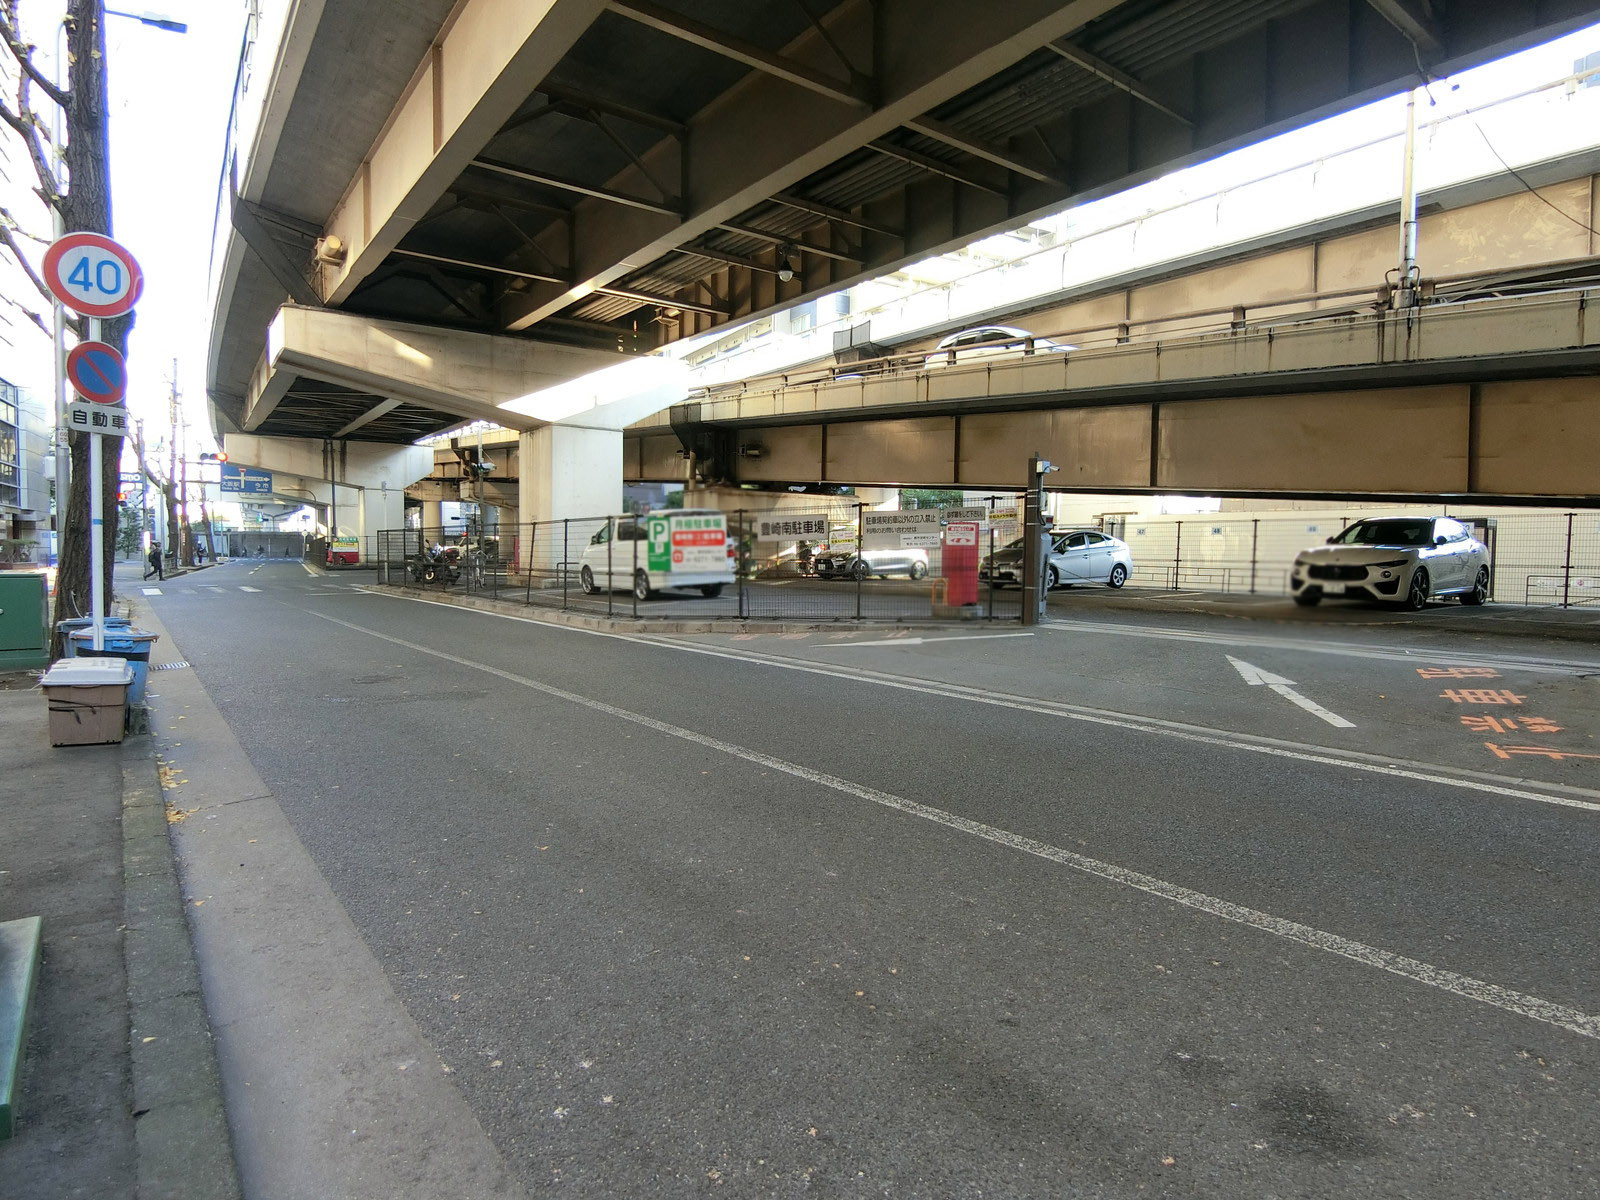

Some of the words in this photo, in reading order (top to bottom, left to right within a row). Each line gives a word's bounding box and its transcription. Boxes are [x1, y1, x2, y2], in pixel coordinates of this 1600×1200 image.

[67, 256, 121, 295] 40
[73, 409, 126, 430] 自動車
[675, 518, 722, 529] 月極駐車場
[761, 520, 825, 536] 豊崎南駐車場
[865, 514, 936, 525] 駐車場契約車以外の立入禁止
[653, 522, 665, 541] P
